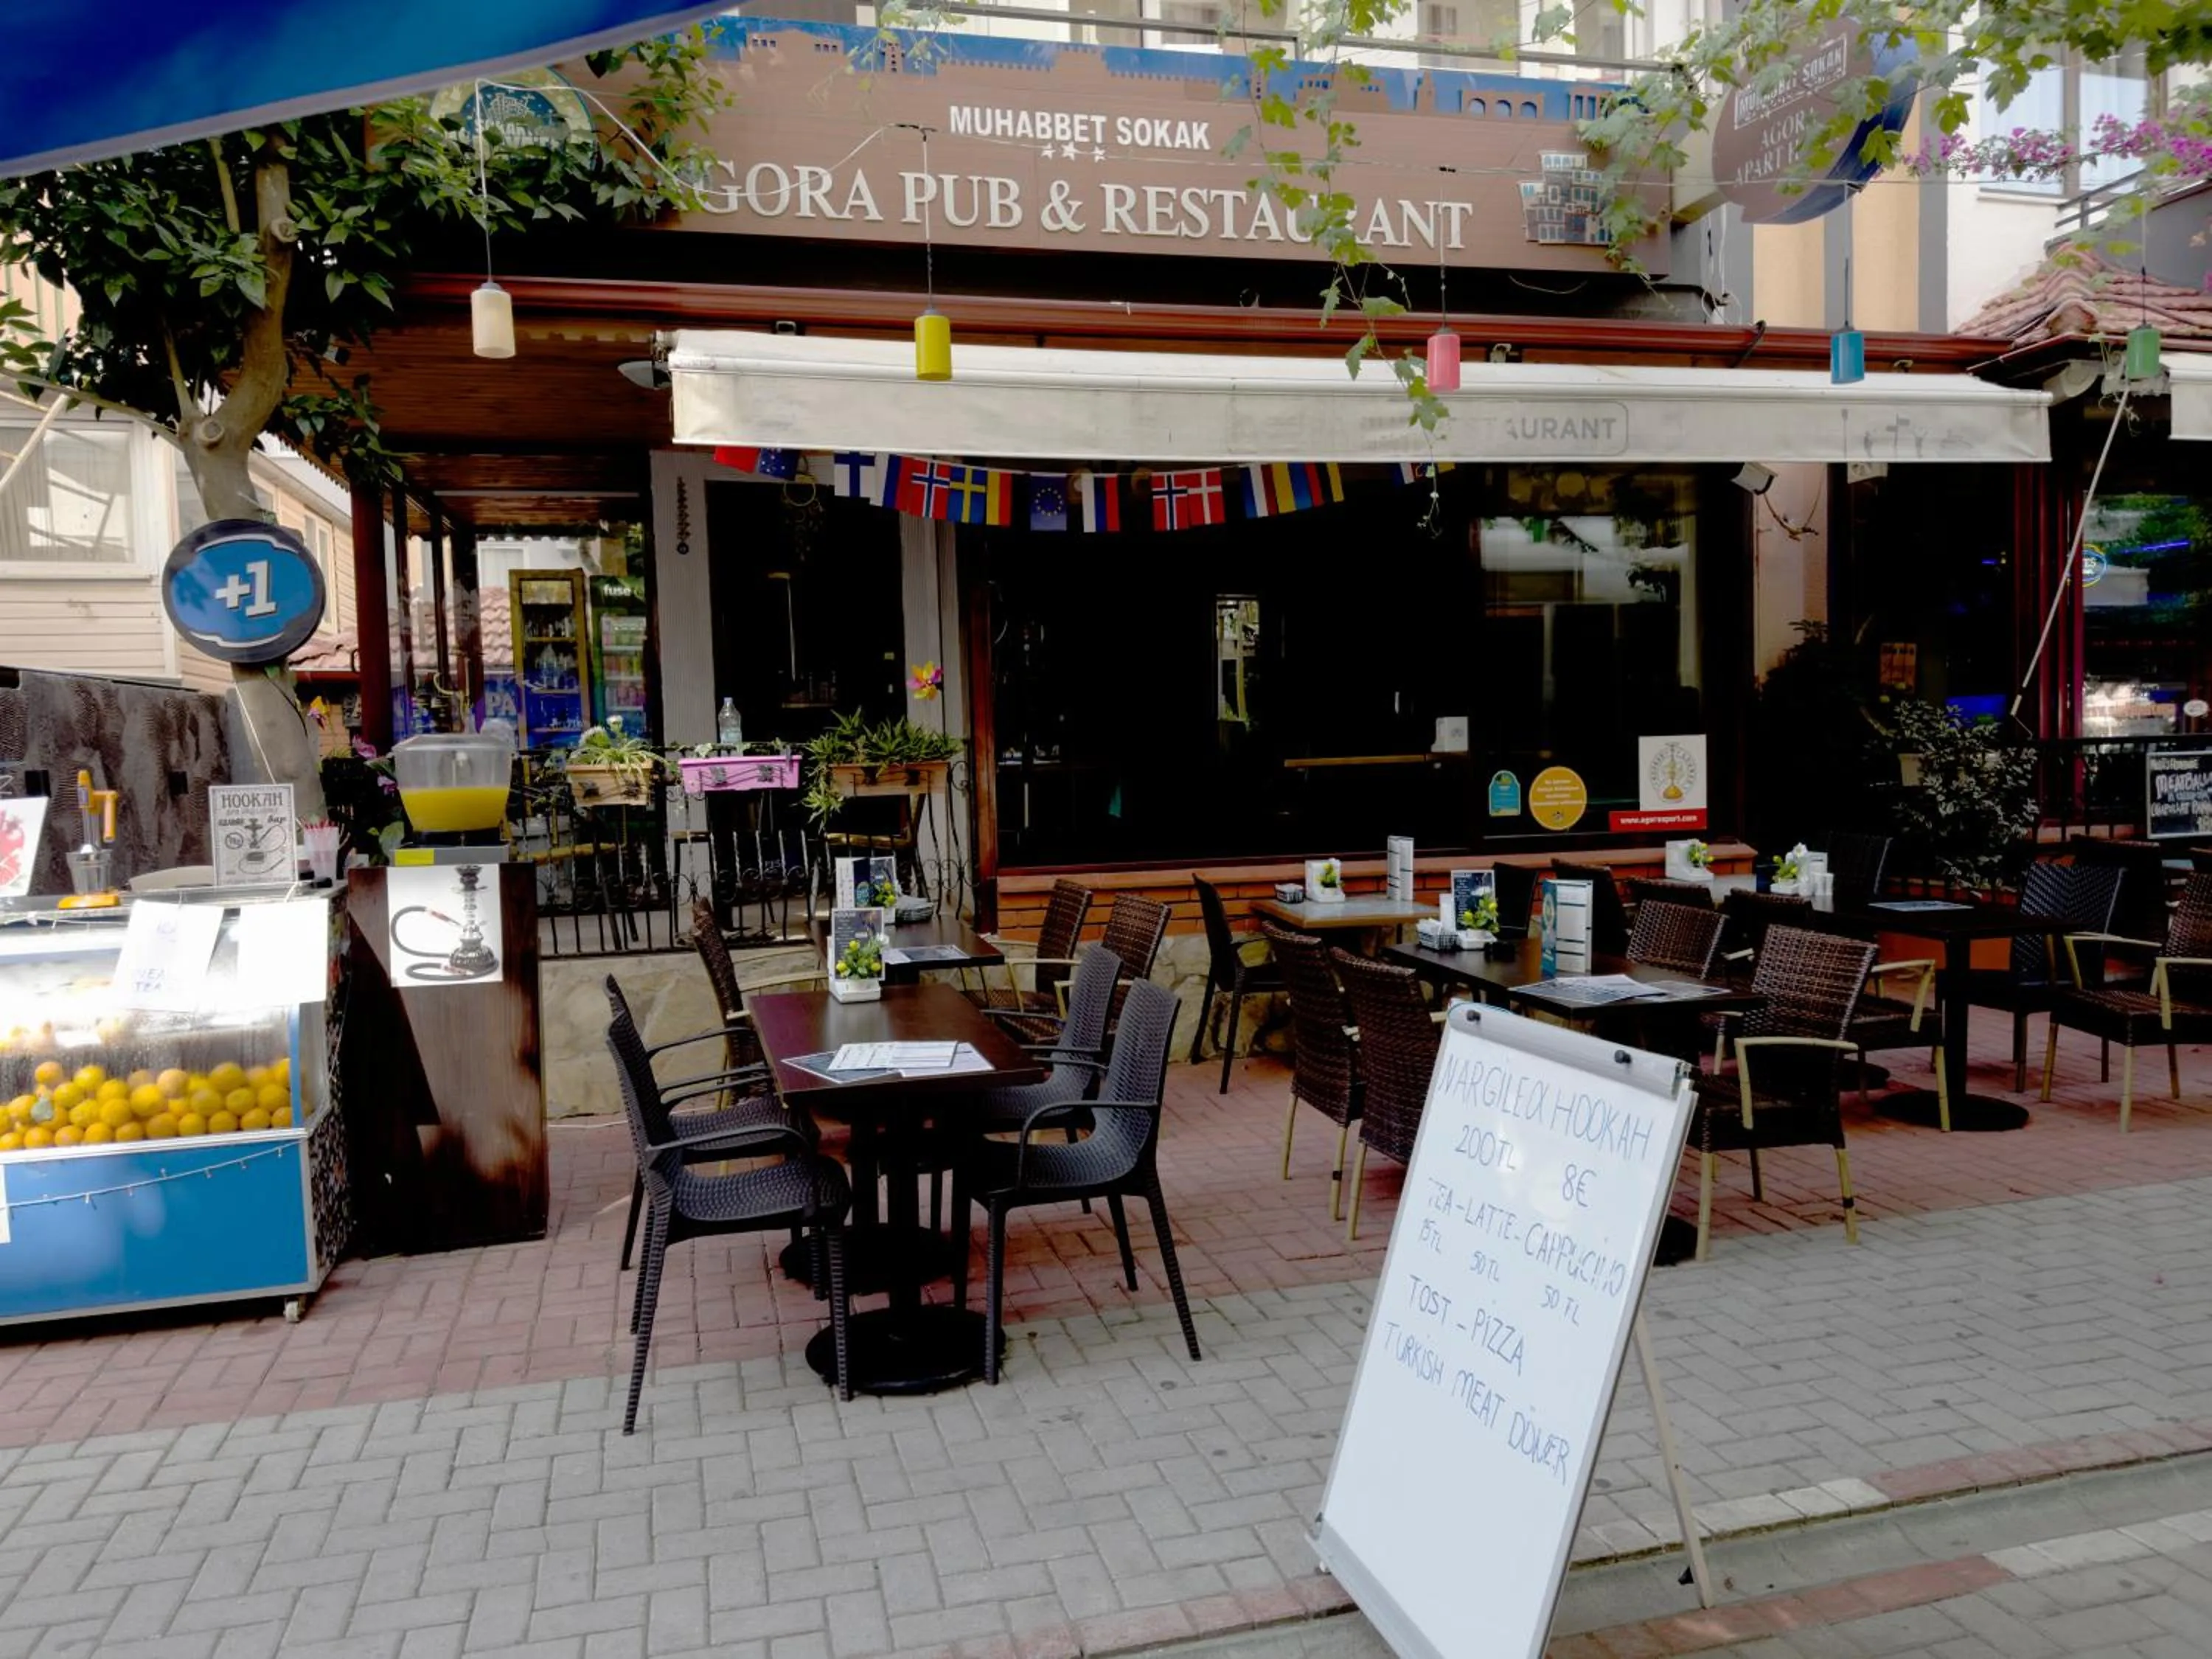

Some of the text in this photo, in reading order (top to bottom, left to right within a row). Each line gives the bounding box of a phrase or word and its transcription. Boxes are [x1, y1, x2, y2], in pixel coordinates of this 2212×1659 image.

[949, 105, 1211, 150] MUHABBET SOKAK
[1760, 106, 1815, 147] AGOR
[672, 158, 1472, 250] GORA PUB & RESTAUANT
[215, 560, 277, 618] +1
[603, 583, 632, 597] fuse
[221, 793, 283, 809] HOOKAH
[1550, 1088, 1654, 1161] HOOKAH
[1409, 1274, 1453, 1326] TOST
[1452, 1369, 1506, 1429] MEAT
